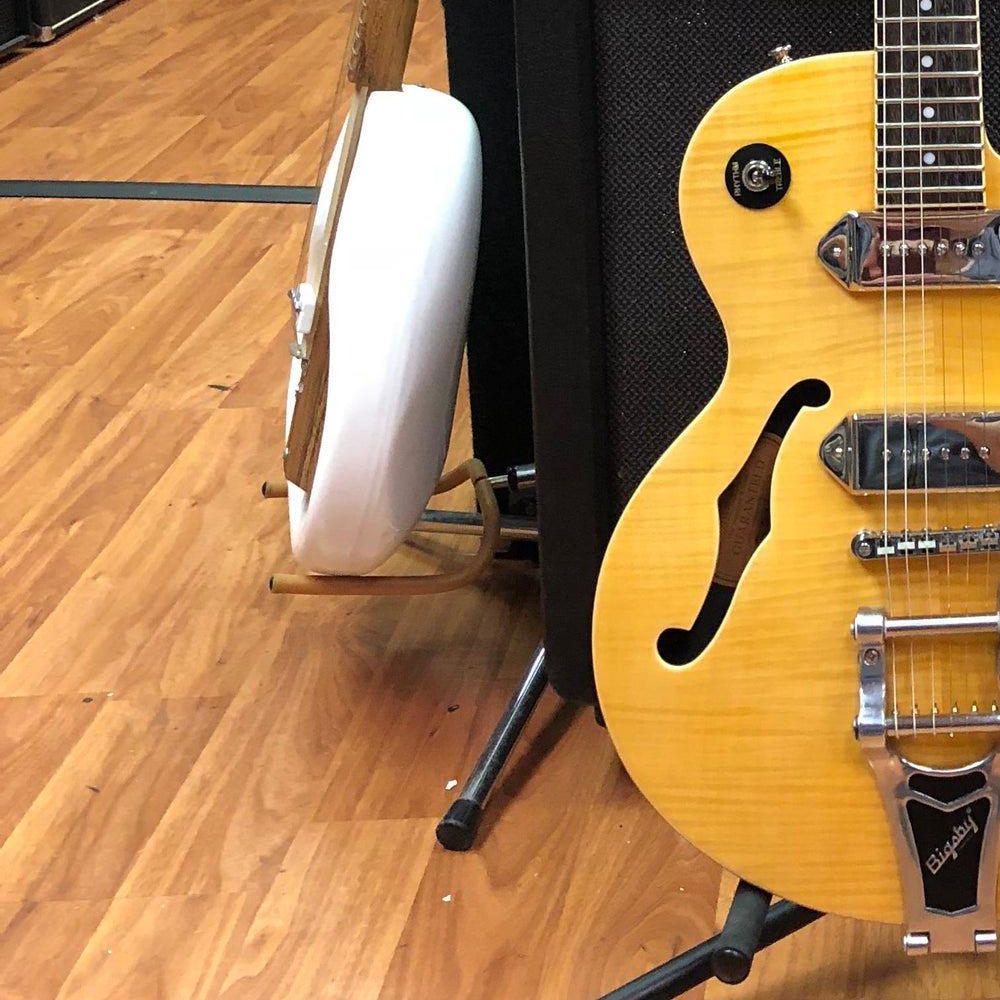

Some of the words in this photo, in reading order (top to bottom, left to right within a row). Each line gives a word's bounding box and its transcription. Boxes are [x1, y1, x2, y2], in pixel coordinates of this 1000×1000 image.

[731, 161, 742, 197] RHYTHM
[773, 157, 784, 192] TREBLE
[925, 814, 979, 875] Bigsby
